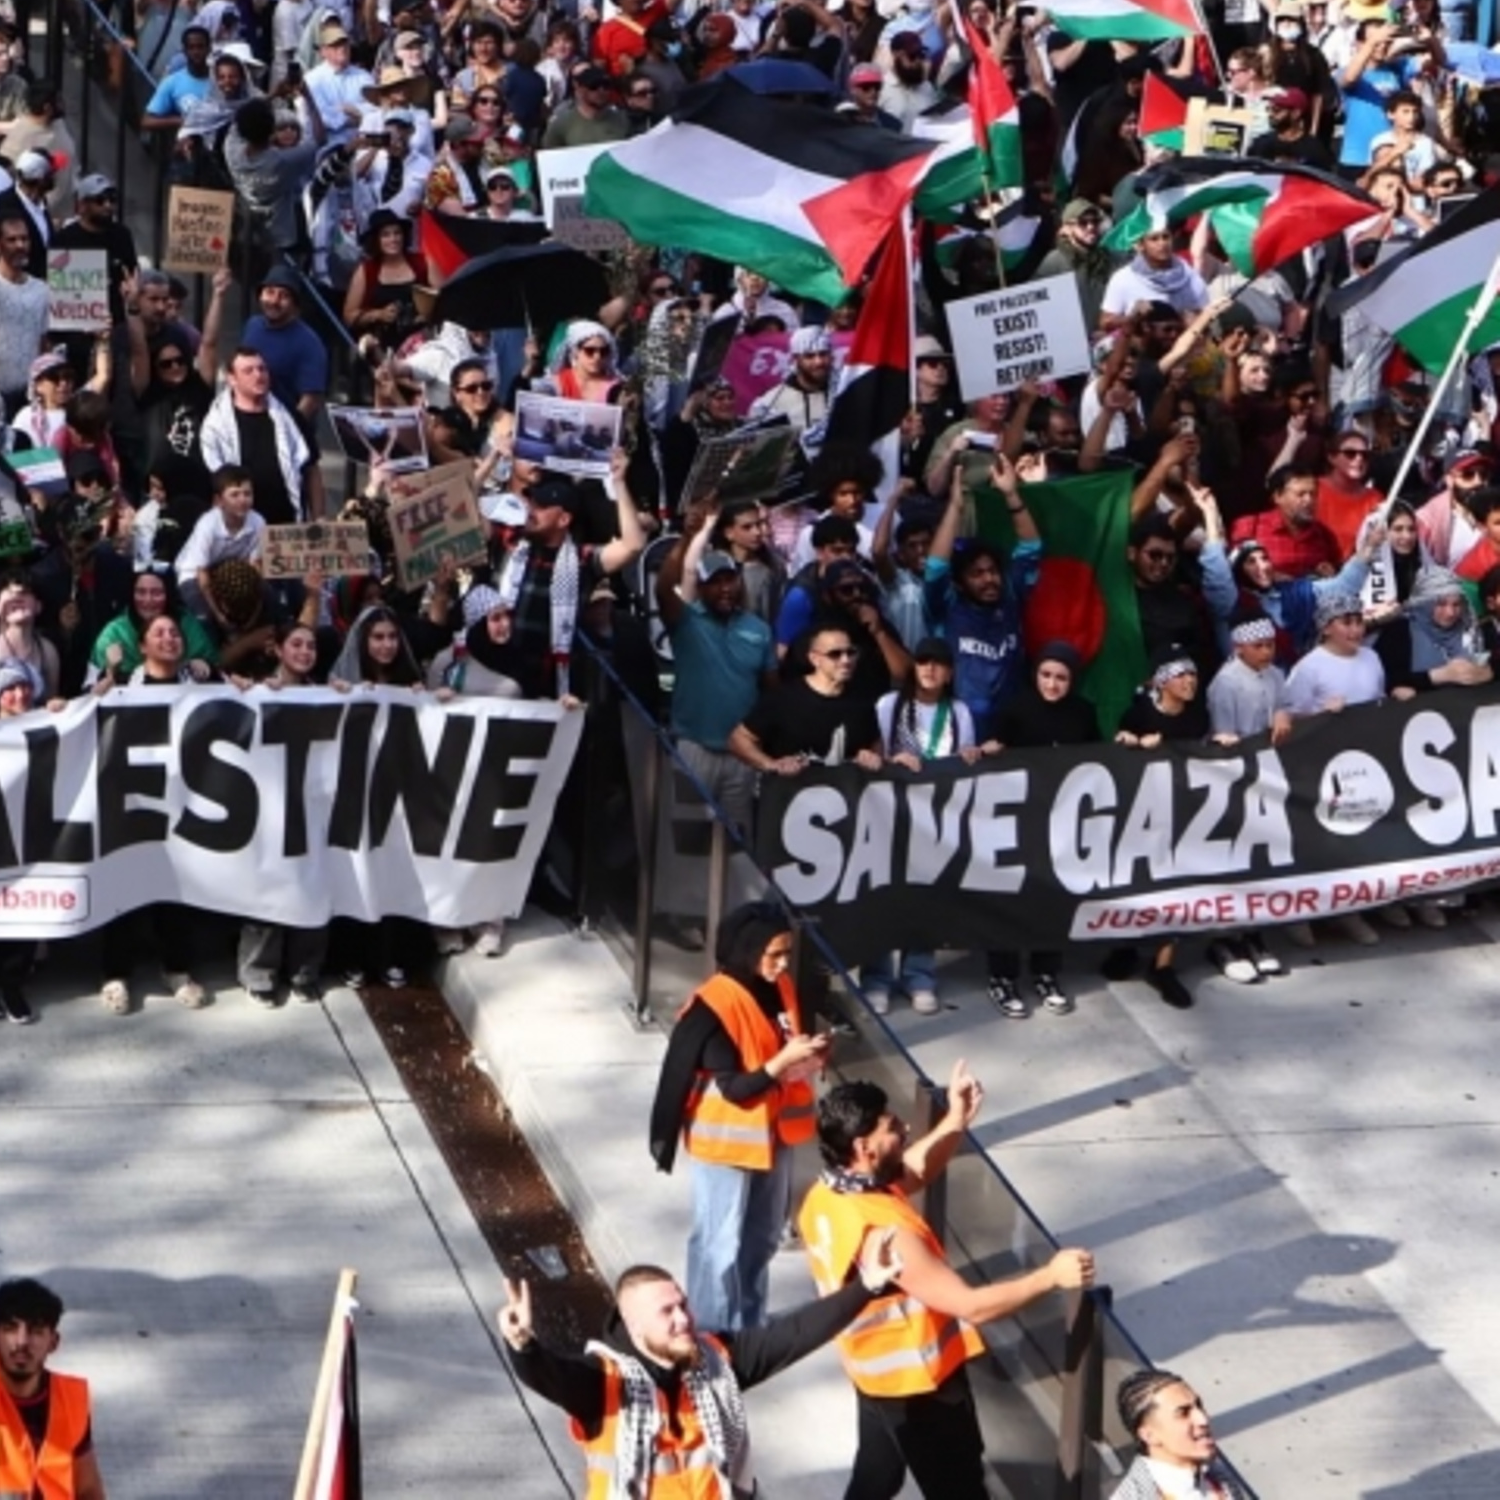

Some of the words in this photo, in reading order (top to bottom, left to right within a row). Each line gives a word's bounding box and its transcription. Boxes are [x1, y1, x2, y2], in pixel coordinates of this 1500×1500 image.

[993, 309, 1039, 337] EXIST!
[395, 491, 449, 533] FREE
[771, 768, 1028, 905] SAVE
[1049, 748, 1296, 896] GAZA
[1086, 894, 1236, 933] JUSTICE
[1246, 888, 1320, 917] FOR
